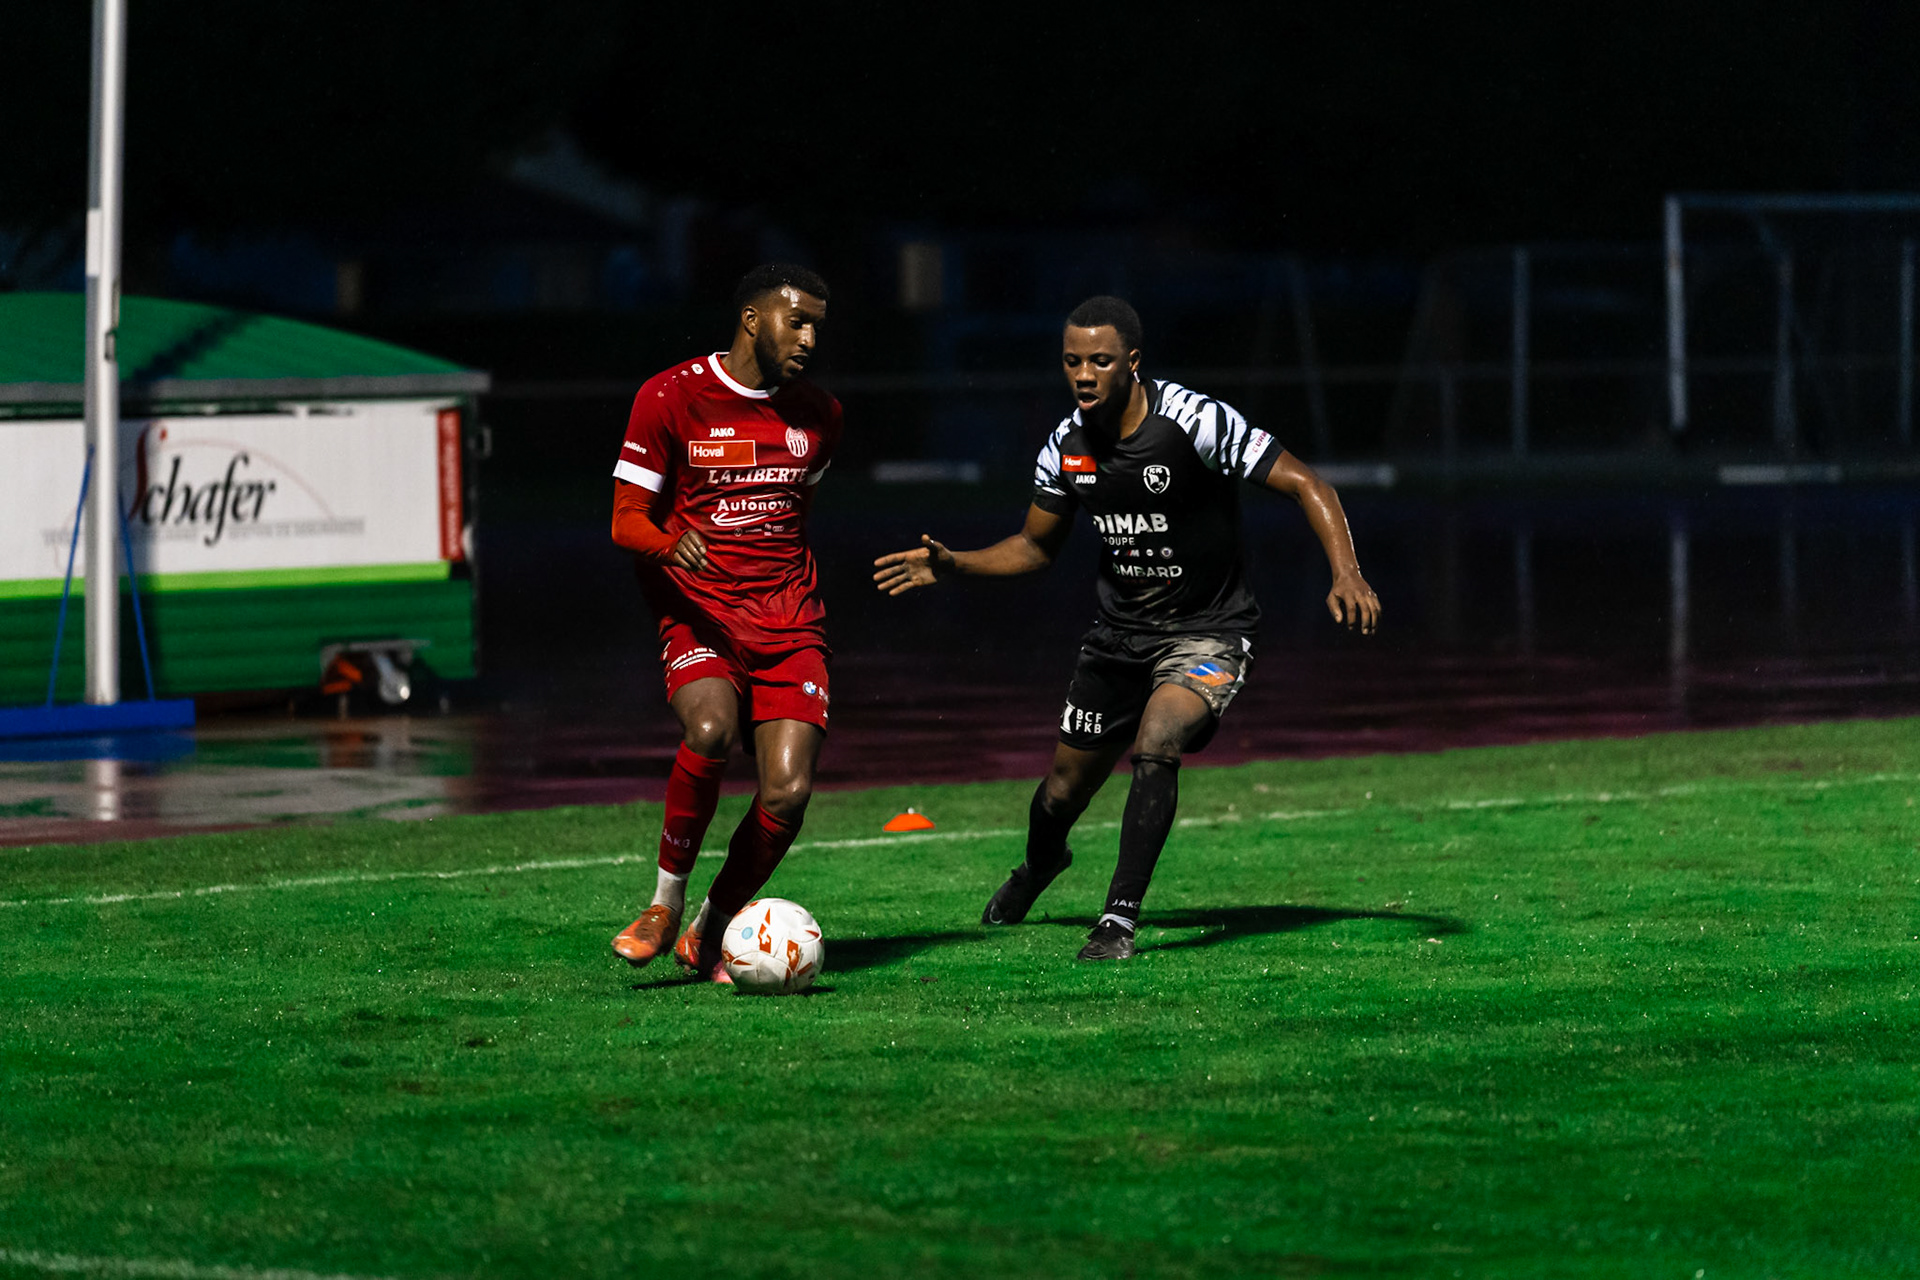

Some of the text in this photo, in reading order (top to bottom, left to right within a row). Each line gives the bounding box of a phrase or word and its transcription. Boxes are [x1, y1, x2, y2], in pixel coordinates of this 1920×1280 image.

[709, 427, 735, 437] JAKO
[693, 445, 724, 457] Hoval
[707, 469, 731, 484] LA
[1075, 474, 1097, 484] JAKO
